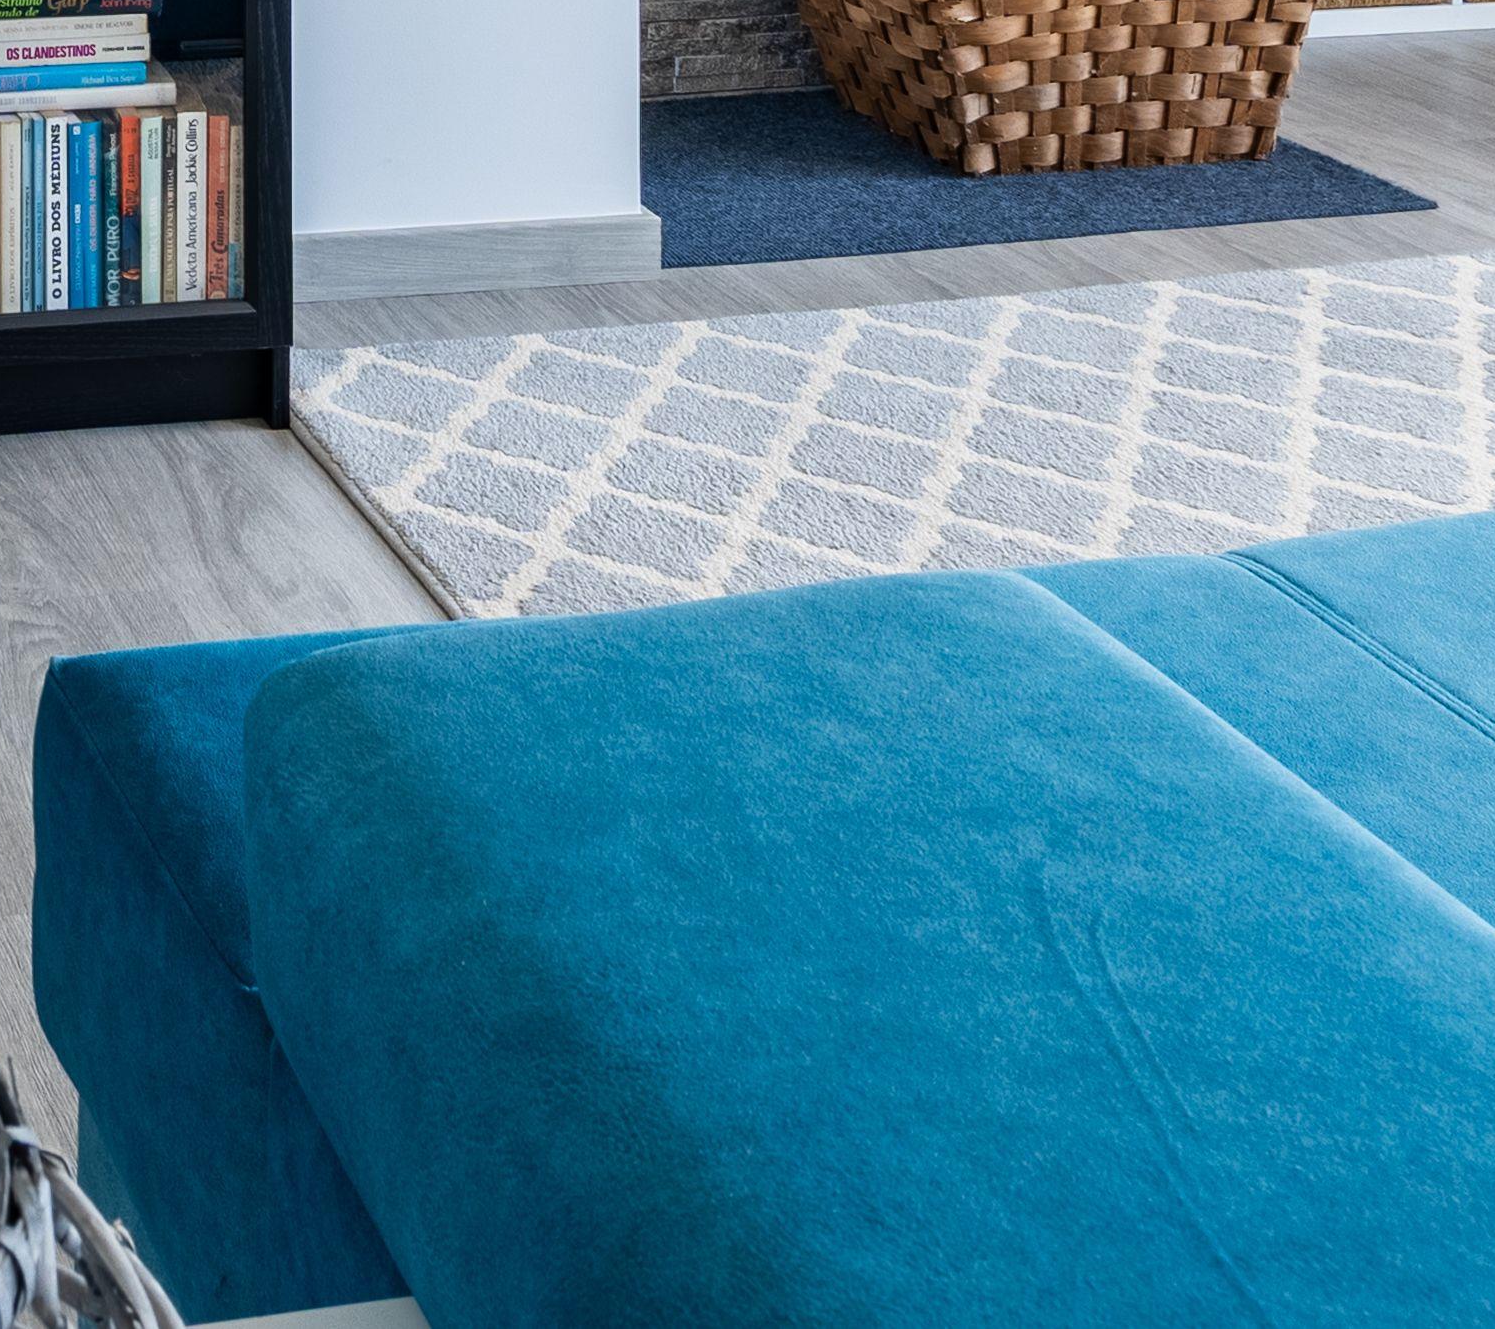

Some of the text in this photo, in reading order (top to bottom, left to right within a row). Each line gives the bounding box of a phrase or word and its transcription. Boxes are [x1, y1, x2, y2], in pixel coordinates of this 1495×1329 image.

[7, 44, 96, 60] OS CLANDESTINOS
[185, 119, 198, 186] Jackie Collins
[50, 124, 62, 299] O LIVRO DOS MÉDIUNS
[186, 191, 197, 291] Vedeta Americana
